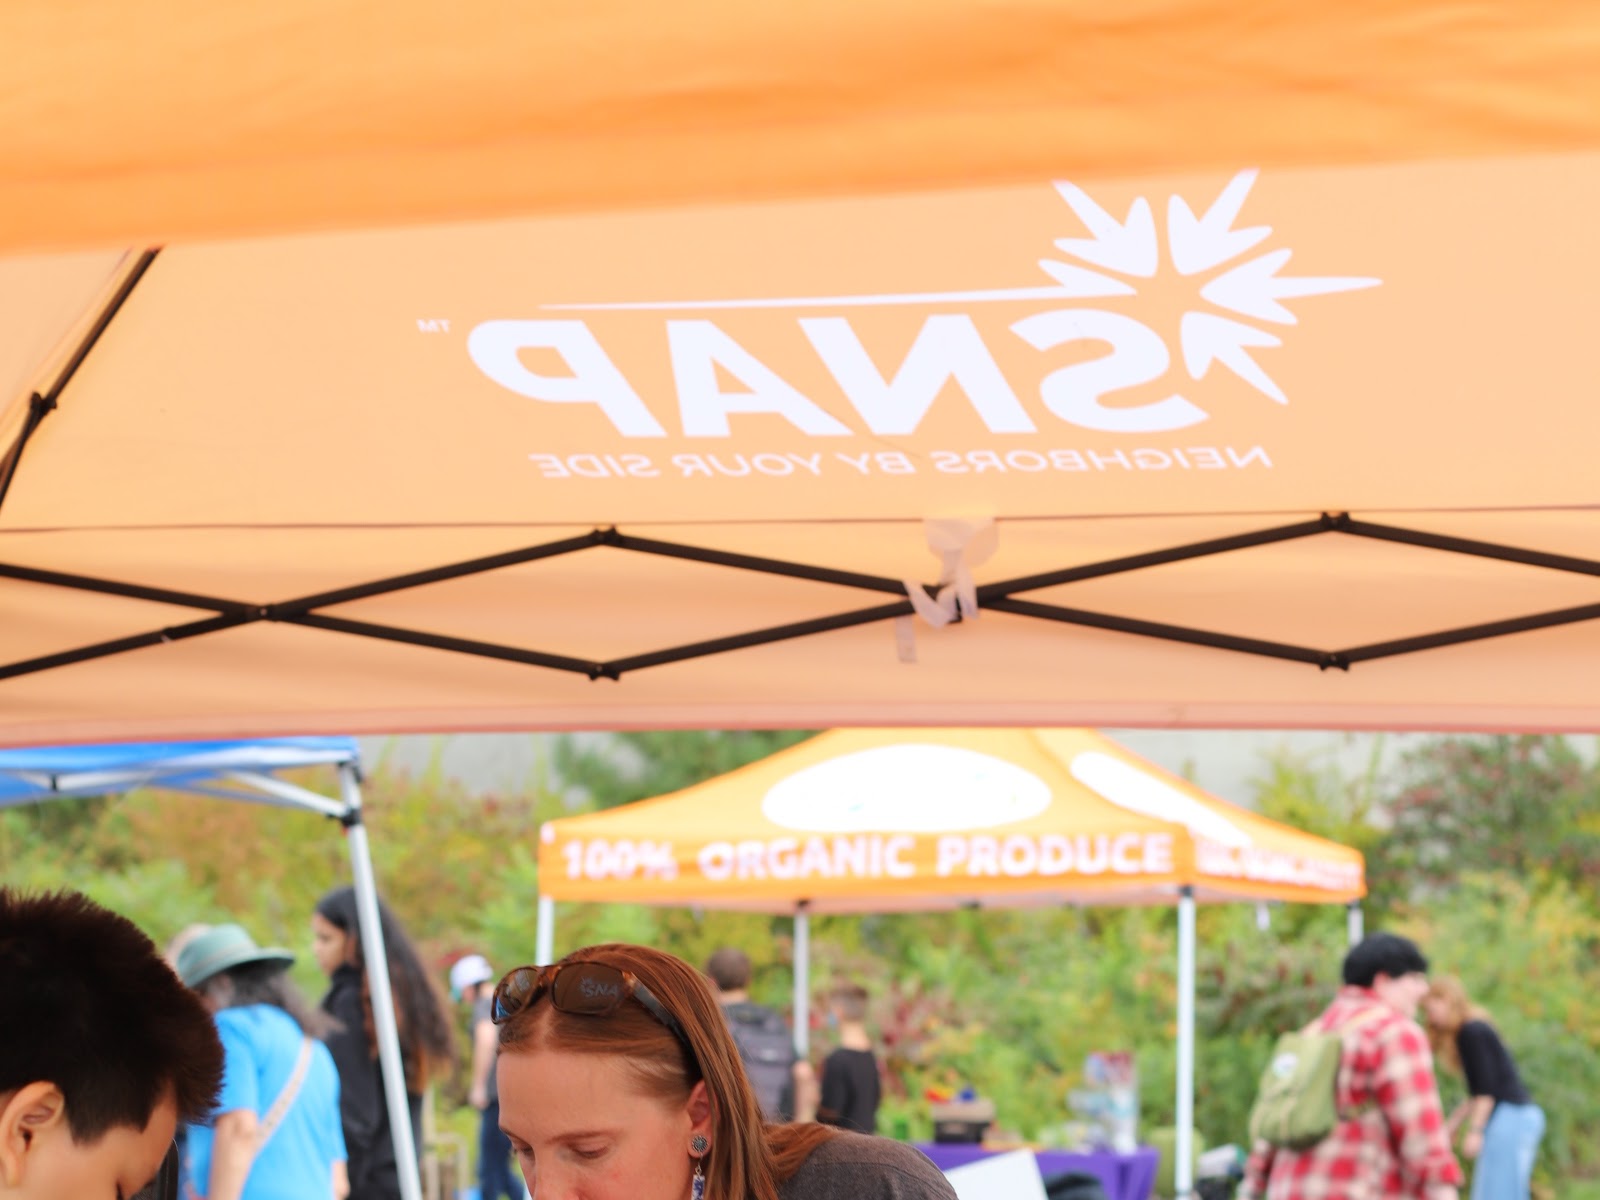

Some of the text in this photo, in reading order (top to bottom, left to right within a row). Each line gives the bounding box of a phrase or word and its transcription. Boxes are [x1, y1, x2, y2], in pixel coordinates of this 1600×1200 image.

[562, 841, 676, 880] 100%
[697, 834, 915, 879] ORGANIC
[936, 832, 1173, 877] PRODUCE
